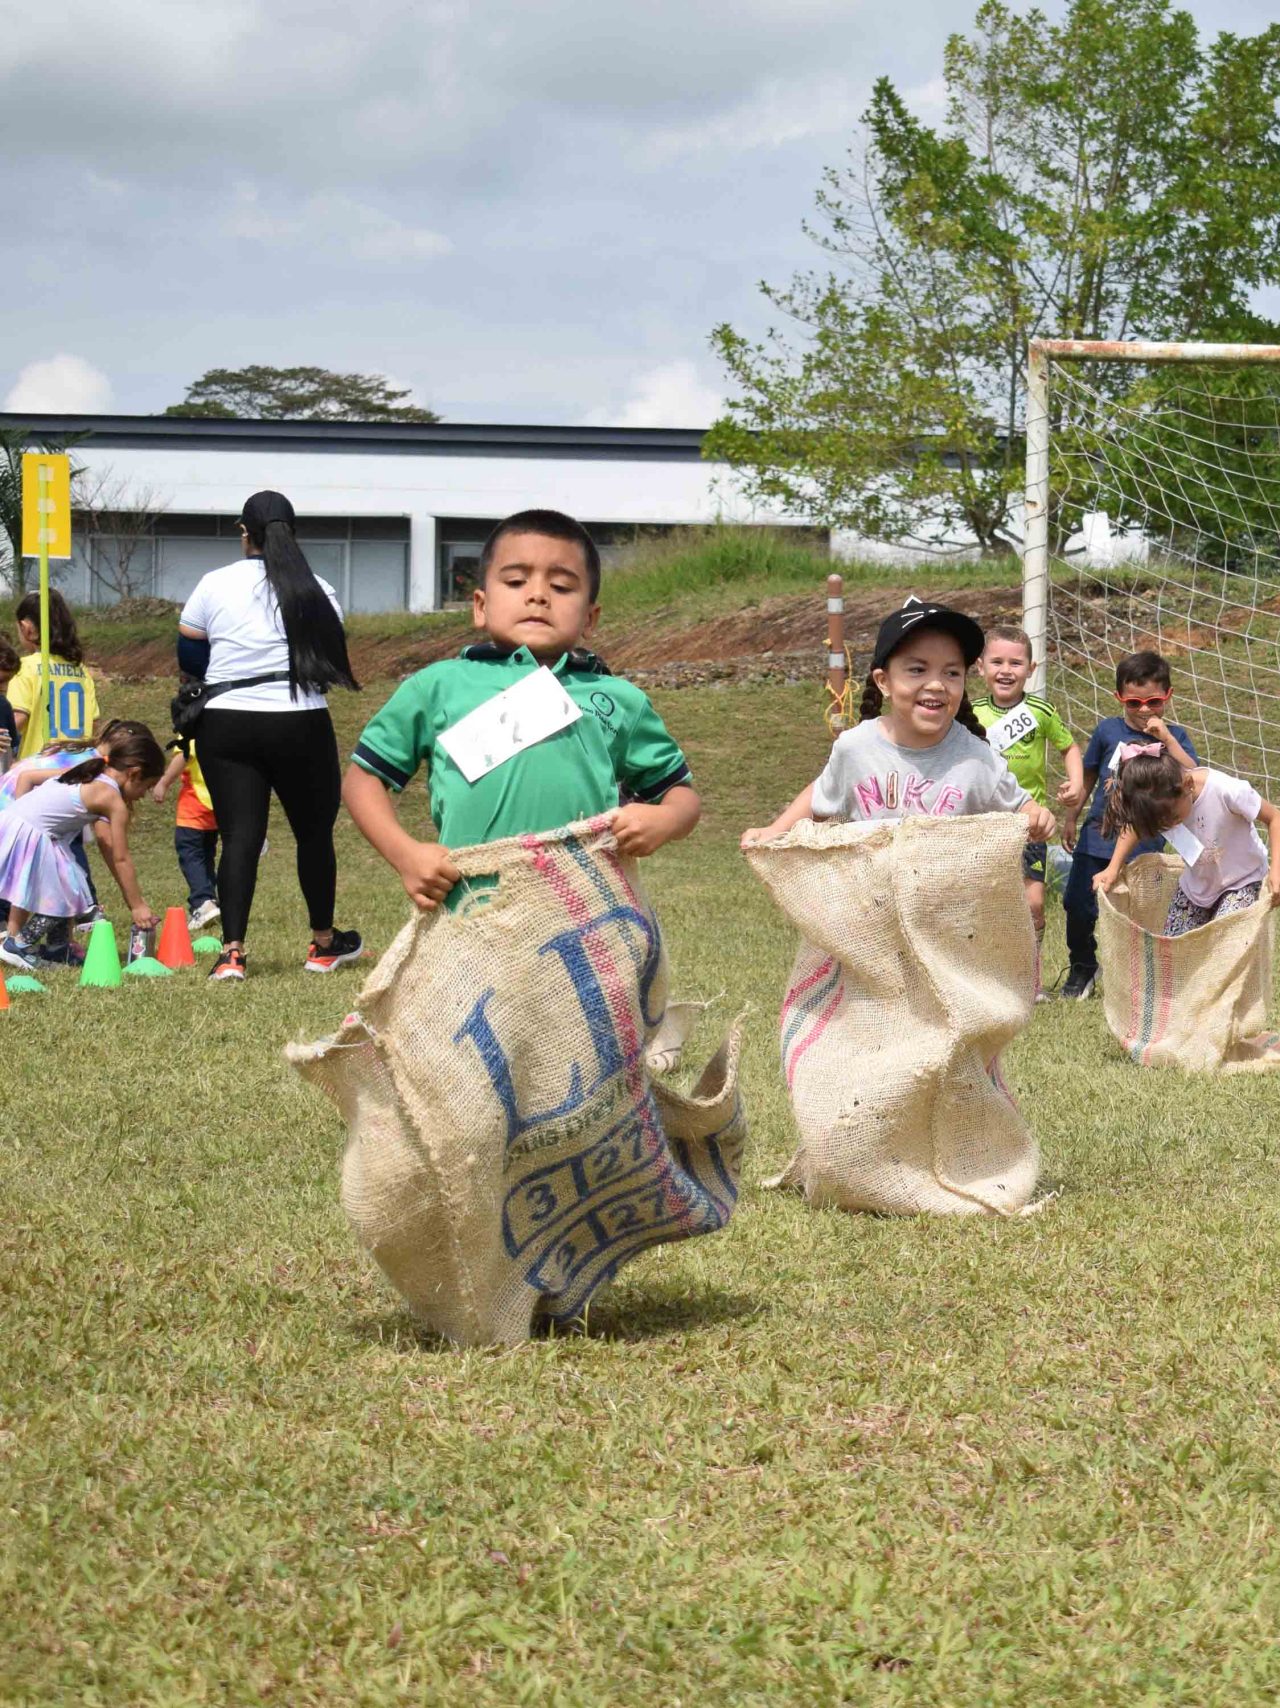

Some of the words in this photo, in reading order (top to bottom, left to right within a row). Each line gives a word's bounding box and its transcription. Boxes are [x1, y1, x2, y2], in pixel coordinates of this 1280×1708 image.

[48, 680, 85, 738] 10
[1003, 712, 1033, 740] 236
[853, 769, 965, 819] NIKE
[526, 1183, 557, 1222] 3
